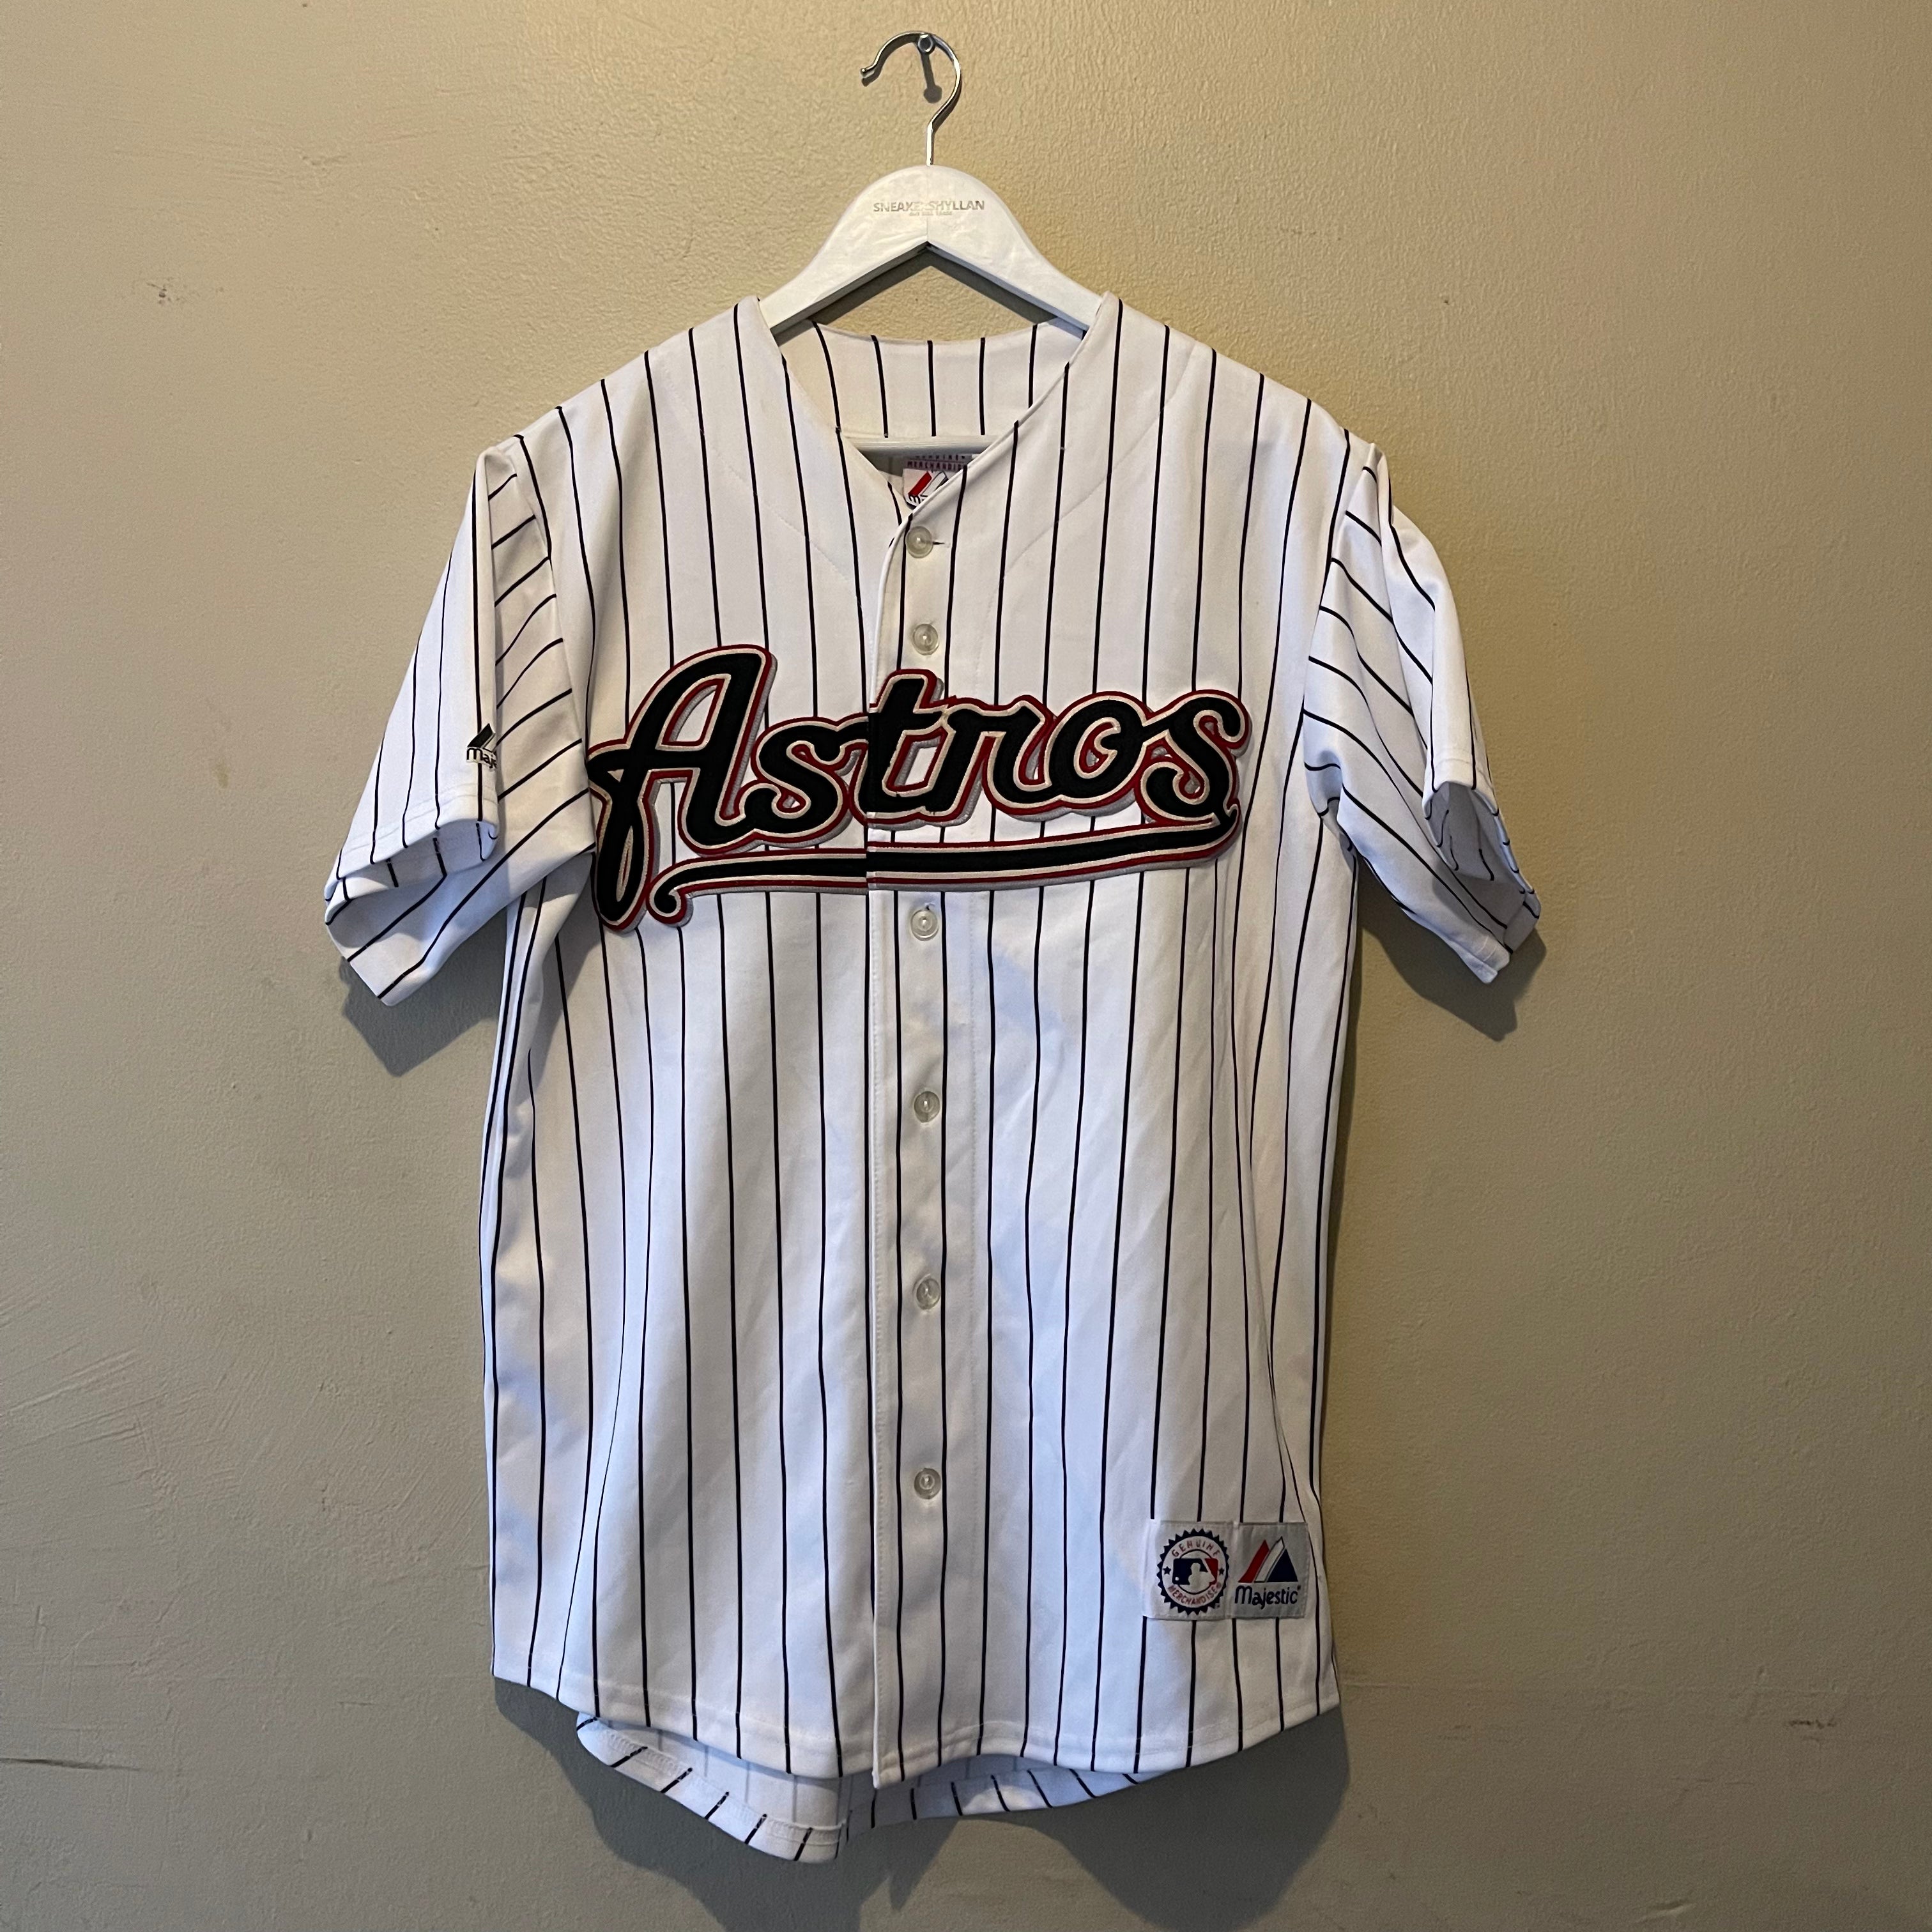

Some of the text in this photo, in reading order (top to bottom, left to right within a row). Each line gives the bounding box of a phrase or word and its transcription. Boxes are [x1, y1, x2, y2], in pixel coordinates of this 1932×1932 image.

[587, 643, 1251, 932] Astros
[1171, 1538, 1221, 1558] GENUINE
[1167, 1584, 1218, 1605] MERCHANDISE
[1234, 1585, 1298, 1609] Majestic
